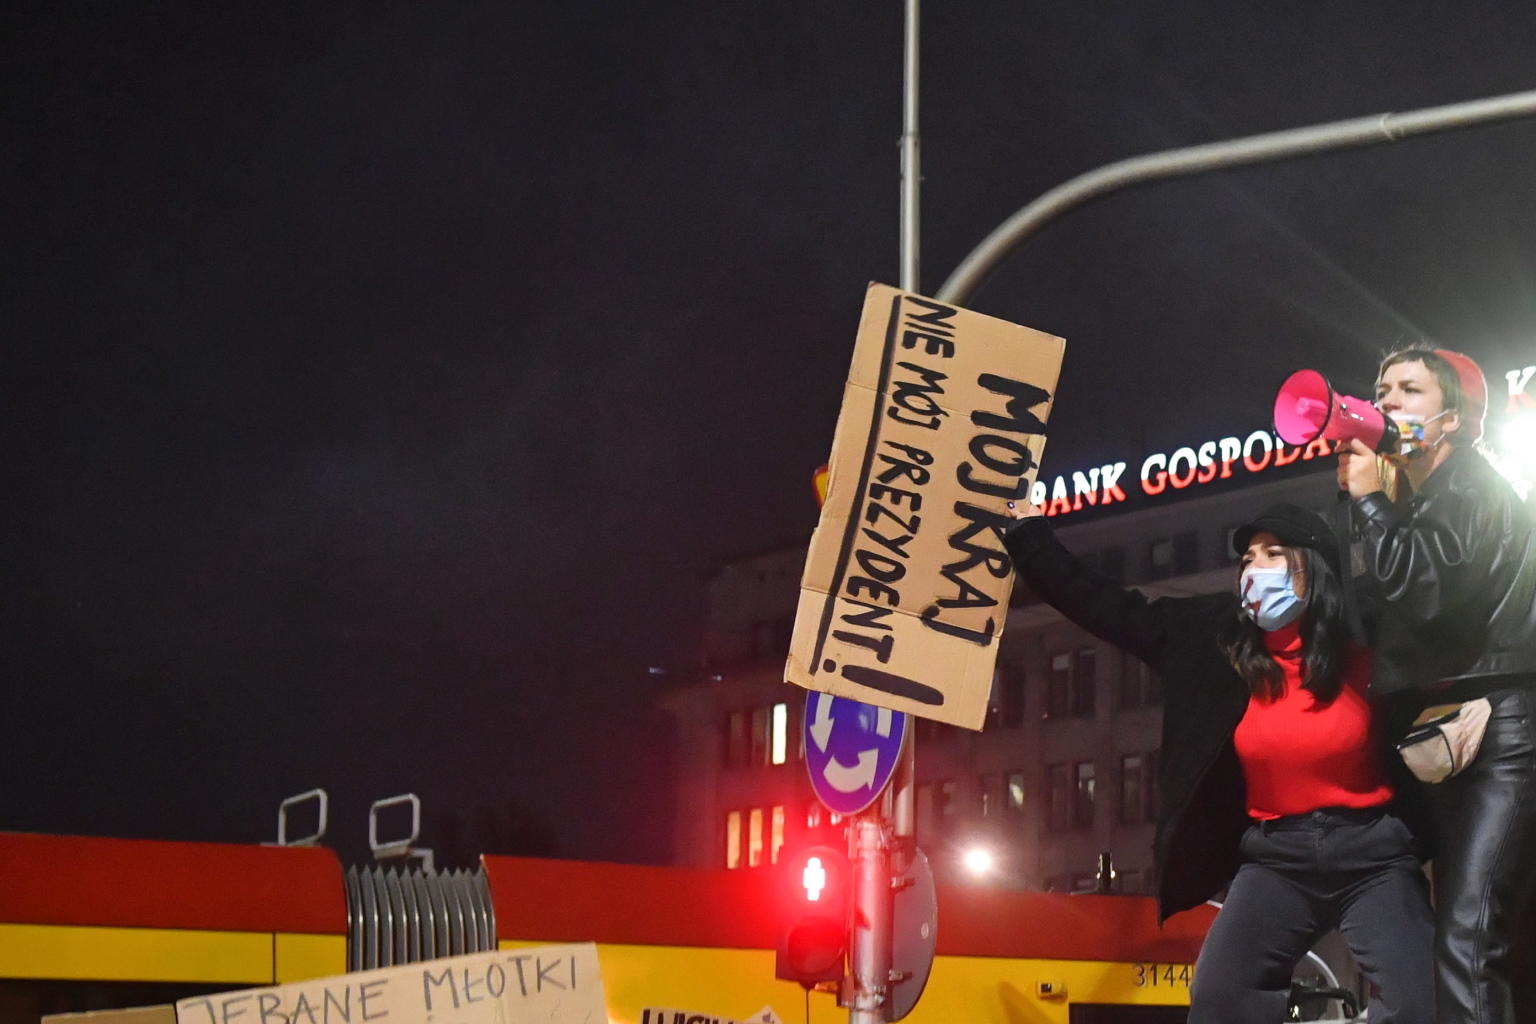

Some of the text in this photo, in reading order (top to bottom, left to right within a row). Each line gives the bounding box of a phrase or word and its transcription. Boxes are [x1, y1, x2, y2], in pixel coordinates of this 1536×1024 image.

[900, 295, 957, 359] NIE
[886, 361, 949, 431] MÓJ
[919, 500, 1012, 647] KRAJ
[422, 954, 577, 1012] MŁOTKI
[1135, 962, 1191, 987] 3144
